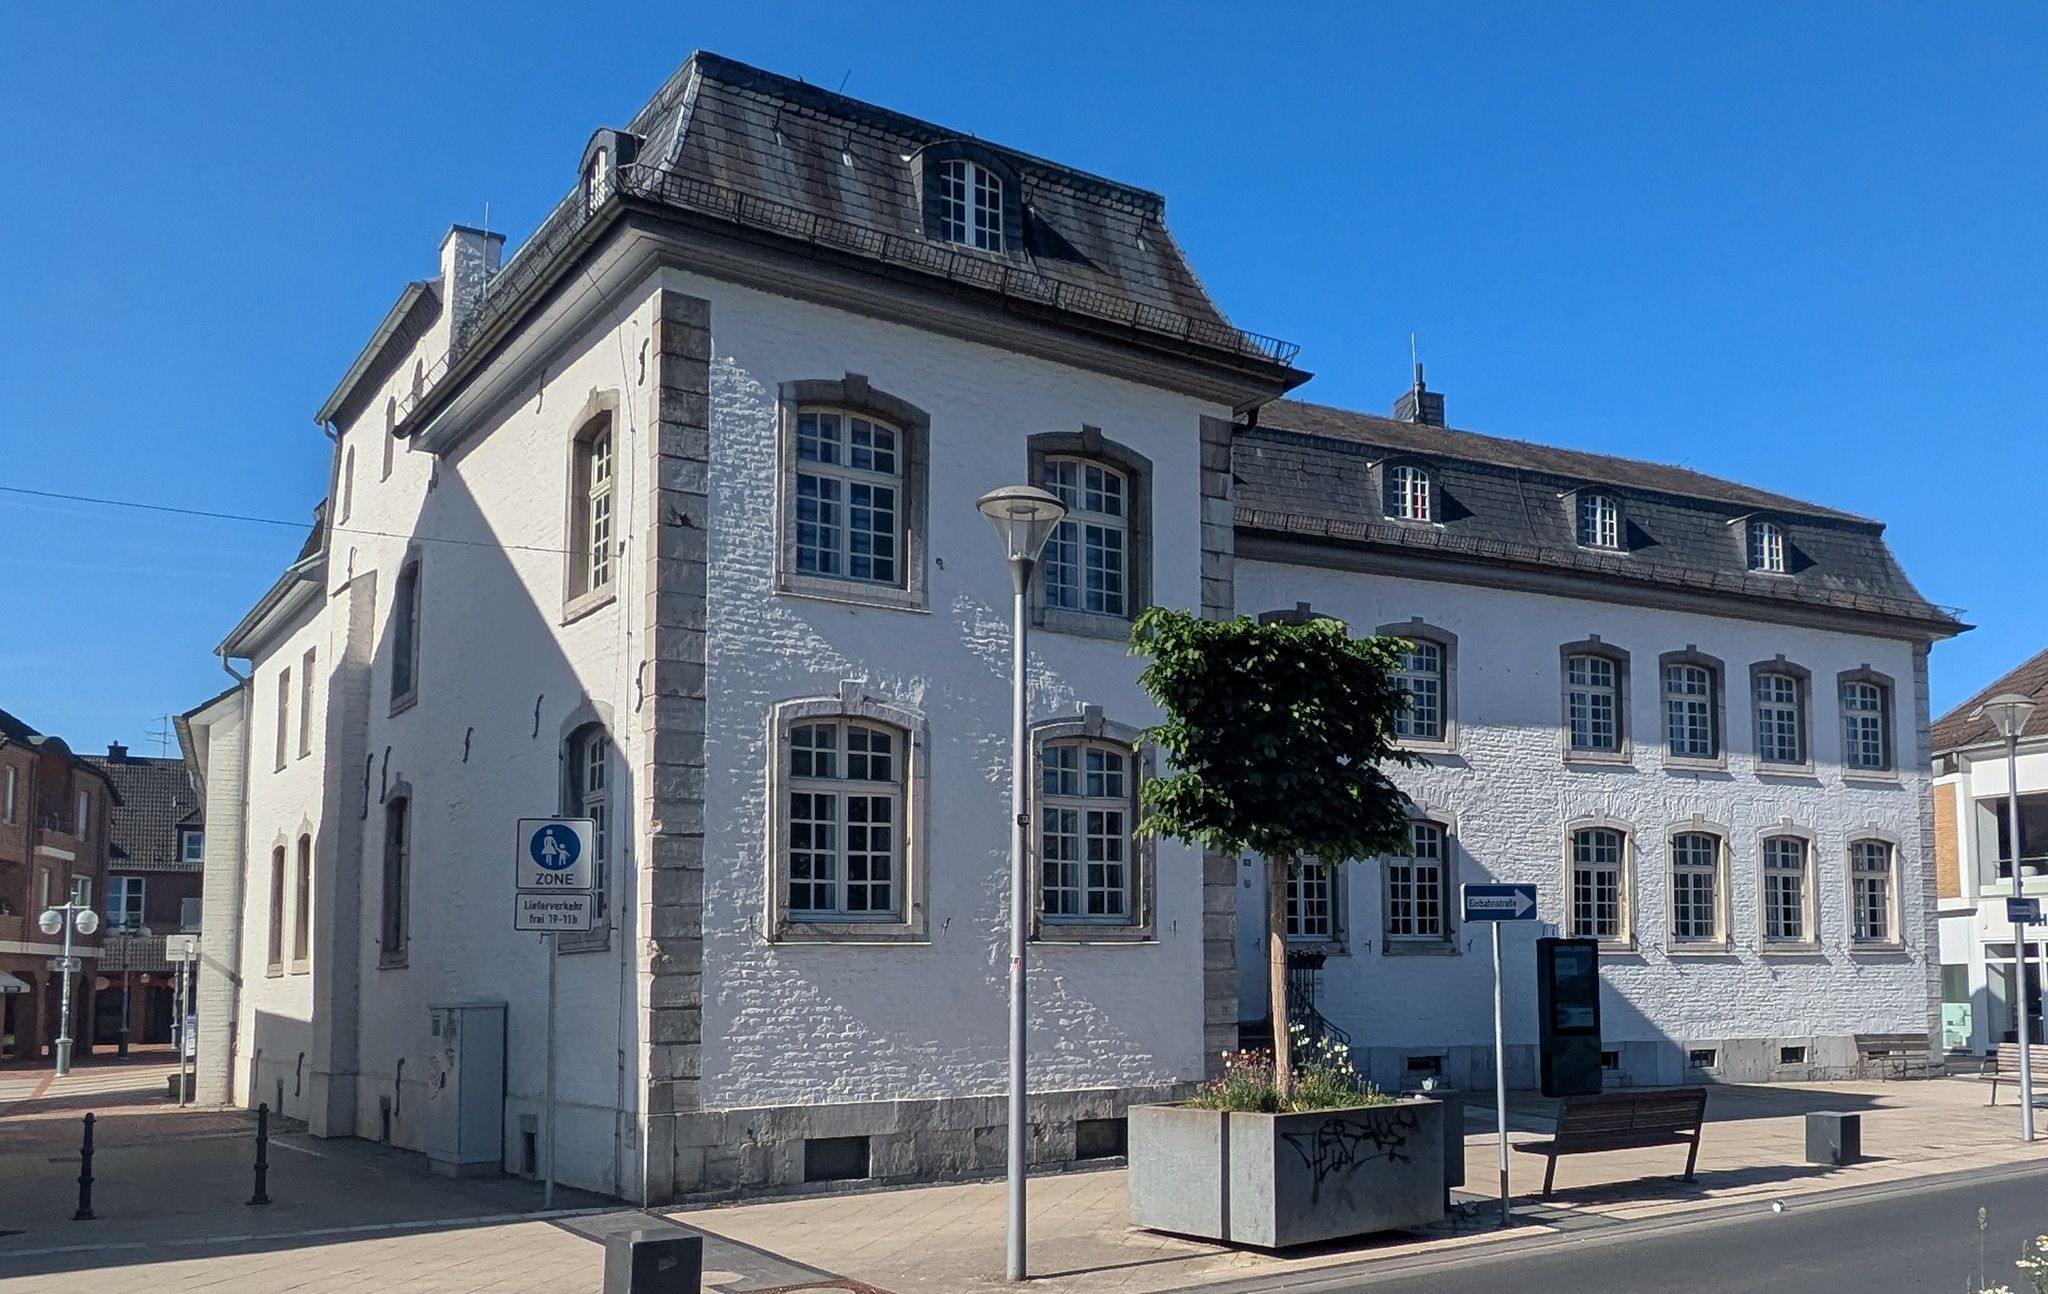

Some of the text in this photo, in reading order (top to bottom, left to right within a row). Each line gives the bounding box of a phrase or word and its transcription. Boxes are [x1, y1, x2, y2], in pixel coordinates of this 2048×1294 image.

[535, 873, 574, 886] ZONE
[524, 900, 583, 911] Lieferverkehr
[529, 914, 545, 924] frei
